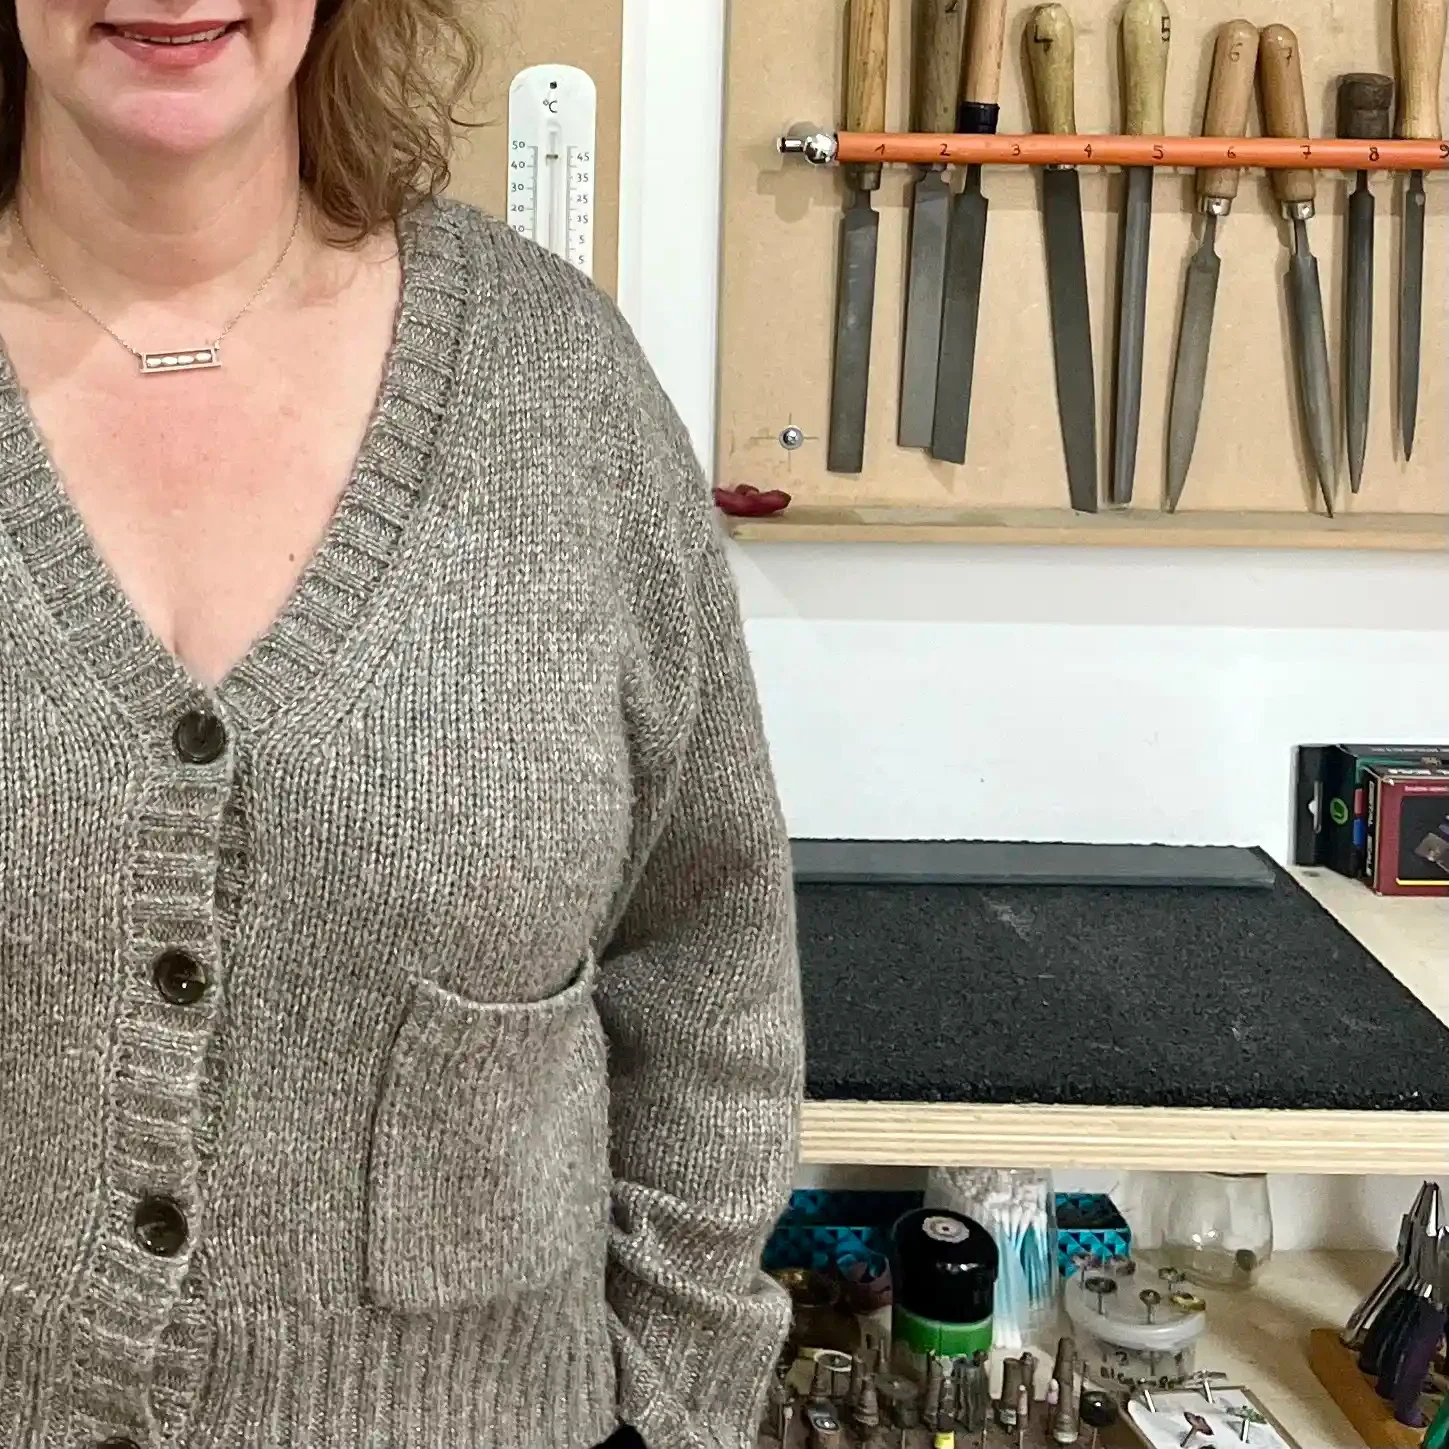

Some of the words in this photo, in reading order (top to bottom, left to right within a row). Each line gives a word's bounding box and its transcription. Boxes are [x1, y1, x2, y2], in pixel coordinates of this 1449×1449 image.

[1161, 15, 1172, 42] 5
[1033, 24, 1054, 55] 4
[1276, 45, 1293, 66] 7
[542, 99, 558, 114] °C
[511, 141, 526, 150] 50
[576, 152, 590, 161] 45
[873, 142, 887, 156] 1
[938, 142, 952, 157] 2
[1010, 142, 1022, 157] 3
[1082, 142, 1093, 159] 4
[1152, 144, 1165, 160] 5
[1226, 145, 1237, 159] 6
[1299, 144, 1313, 160] 7
[1368, 145, 1380, 162] 8
[1439, 143, 1449, 159] 9
[510, 161, 526, 169] 40
[576, 173, 589, 182] 35
[510, 183, 525, 192] 30
[576, 194, 589, 204] 25
[510, 204, 525, 213] 20
